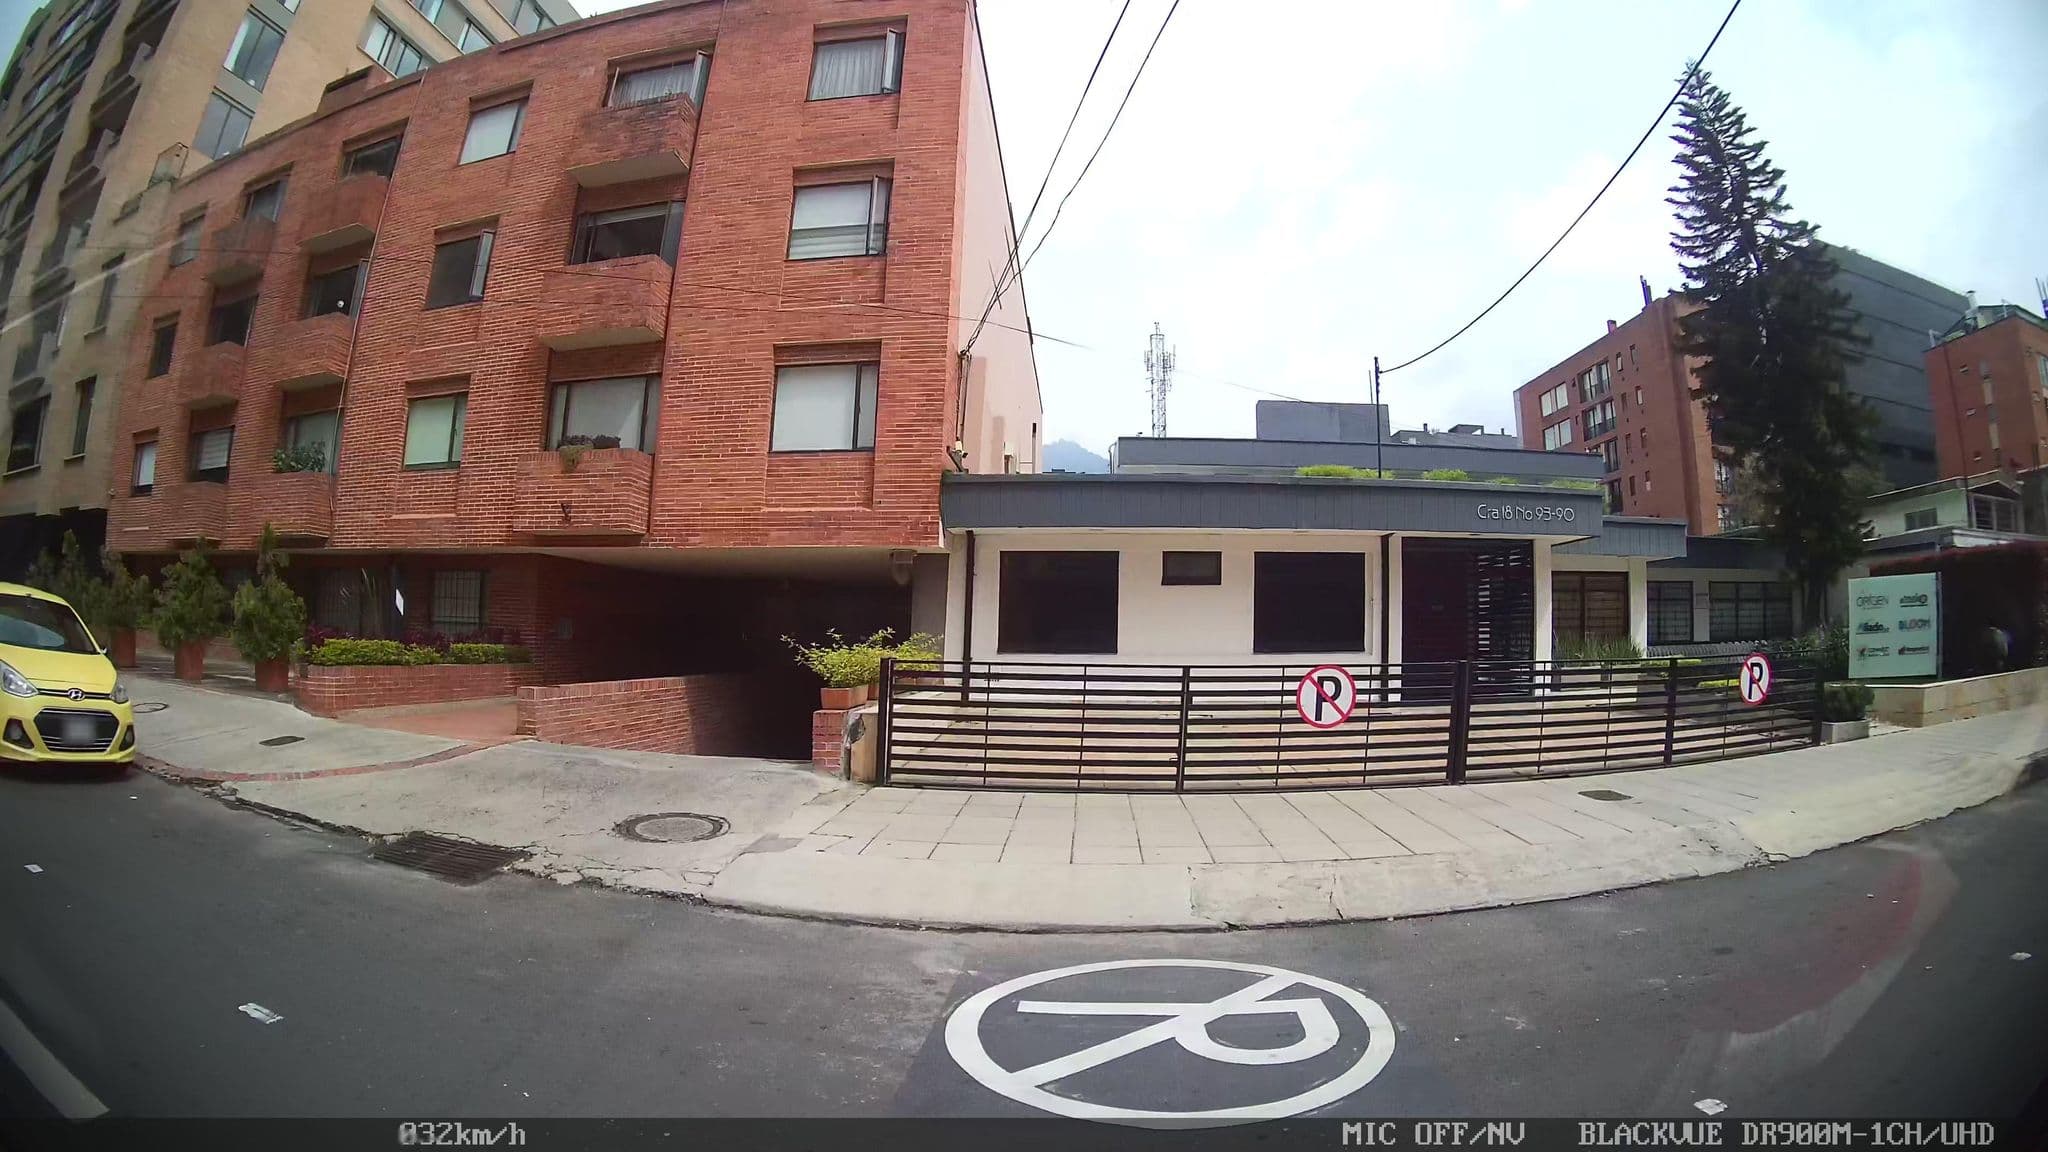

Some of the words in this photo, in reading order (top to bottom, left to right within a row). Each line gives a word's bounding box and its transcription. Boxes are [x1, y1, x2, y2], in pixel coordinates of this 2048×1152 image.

[1477, 504, 1499, 519] Cra
[1502, 505, 1513, 520] 18
[1515, 506, 1533, 521] No
[1535, 506, 1575, 522] 93-90
